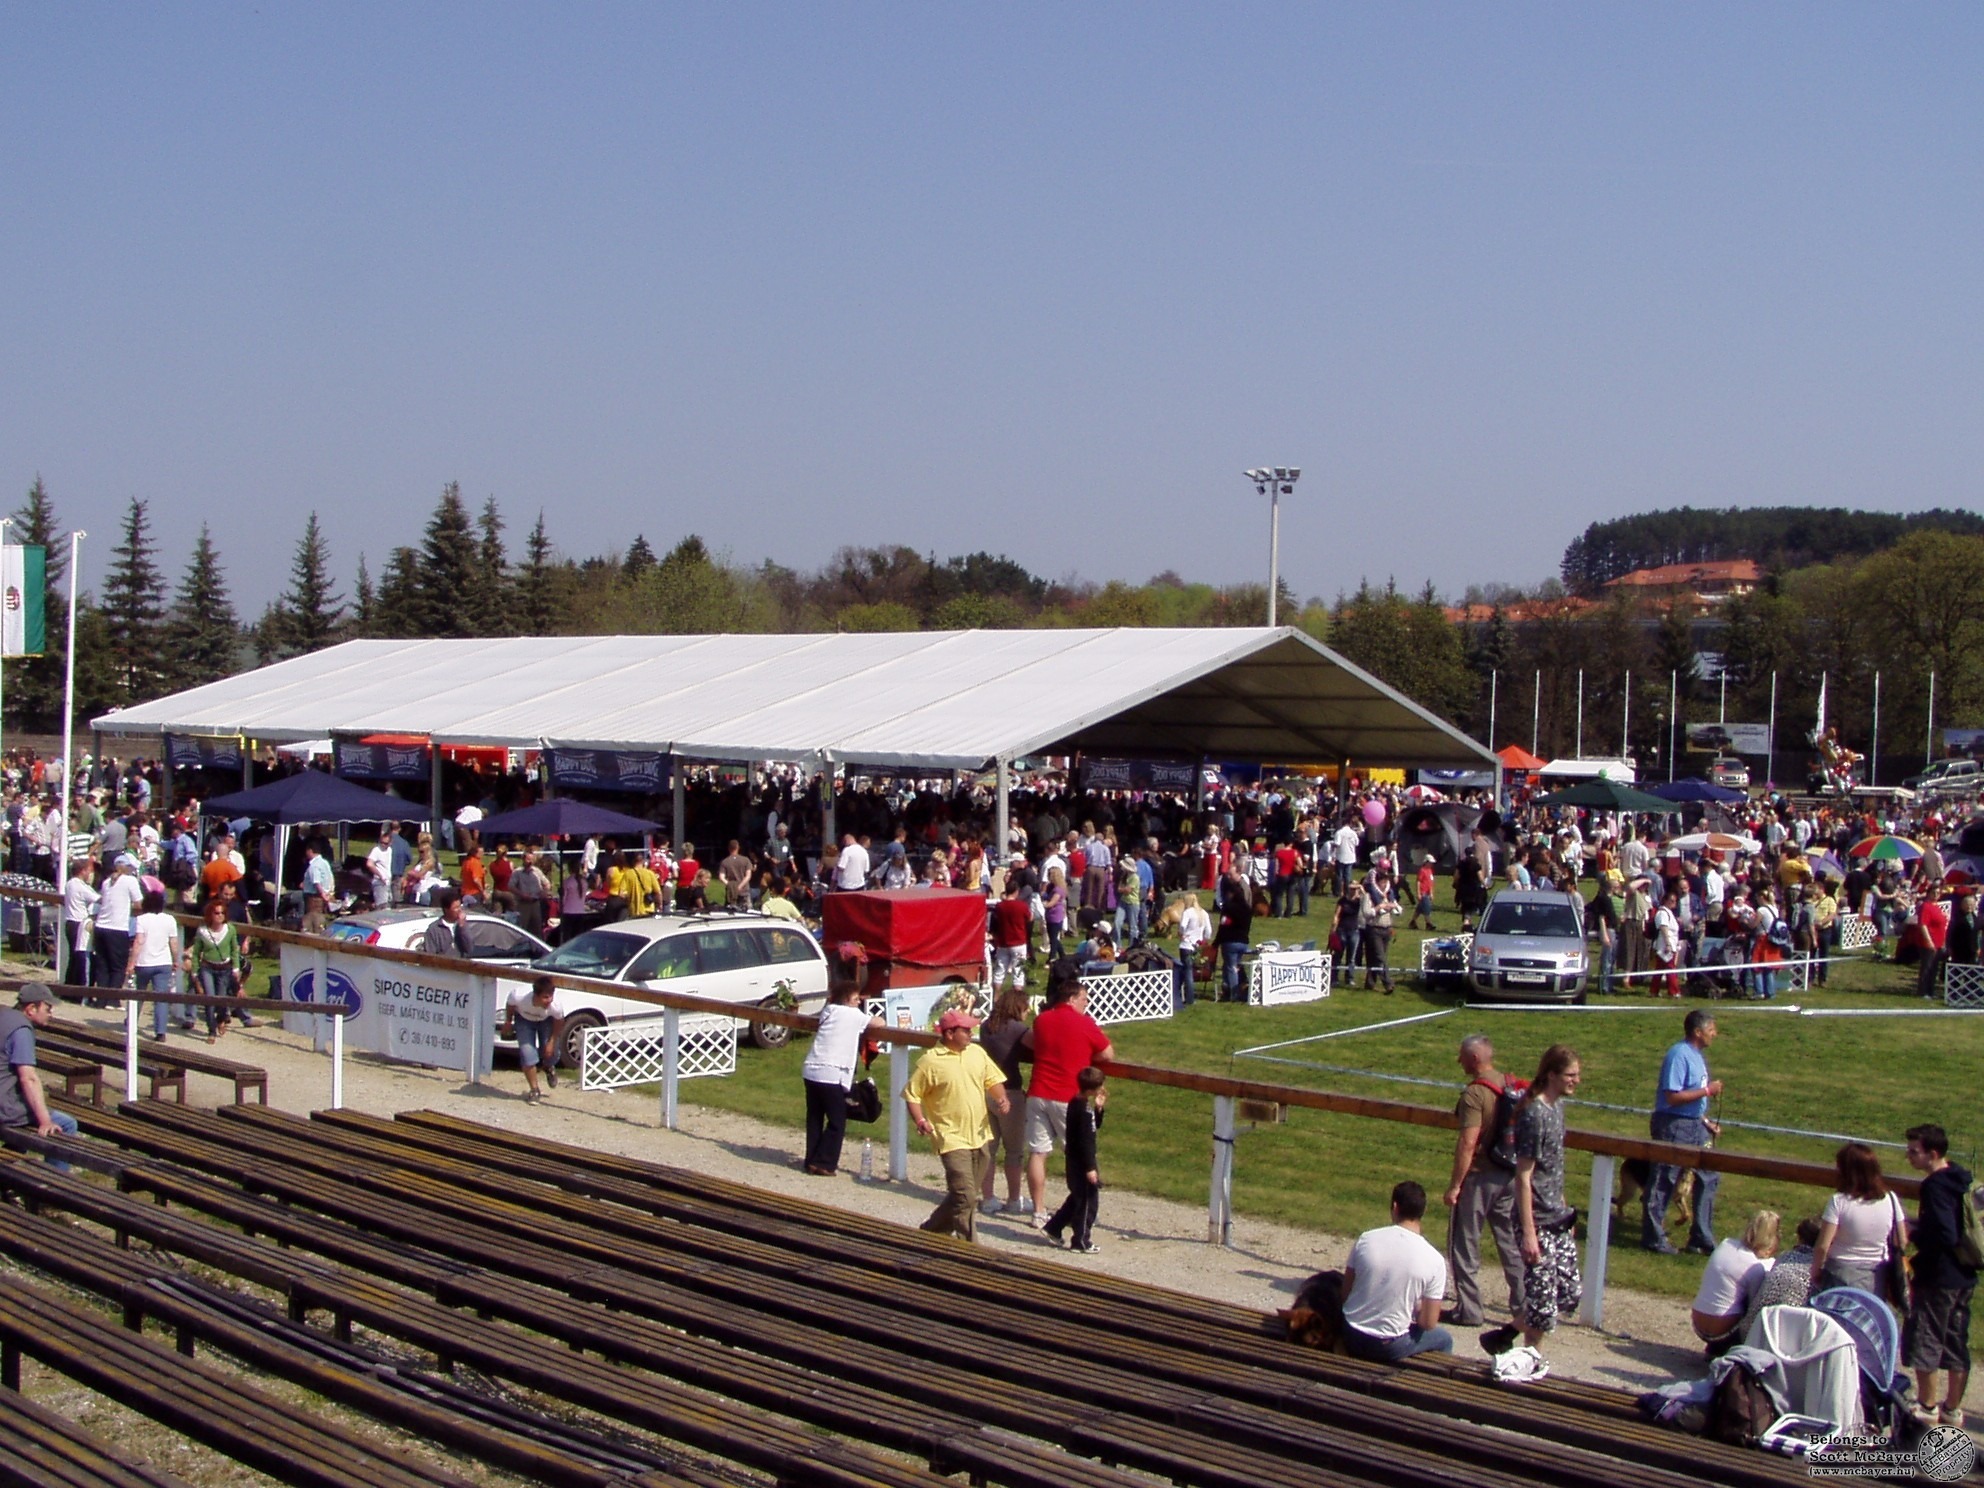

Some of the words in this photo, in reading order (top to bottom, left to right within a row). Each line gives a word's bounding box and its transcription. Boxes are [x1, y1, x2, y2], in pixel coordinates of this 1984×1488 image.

[1271, 966, 1297, 987] HAPPY
[1299, 966, 1315, 984] DOG
[374, 979, 411, 999] SIPOS
[416, 985, 451, 1006] EGER
